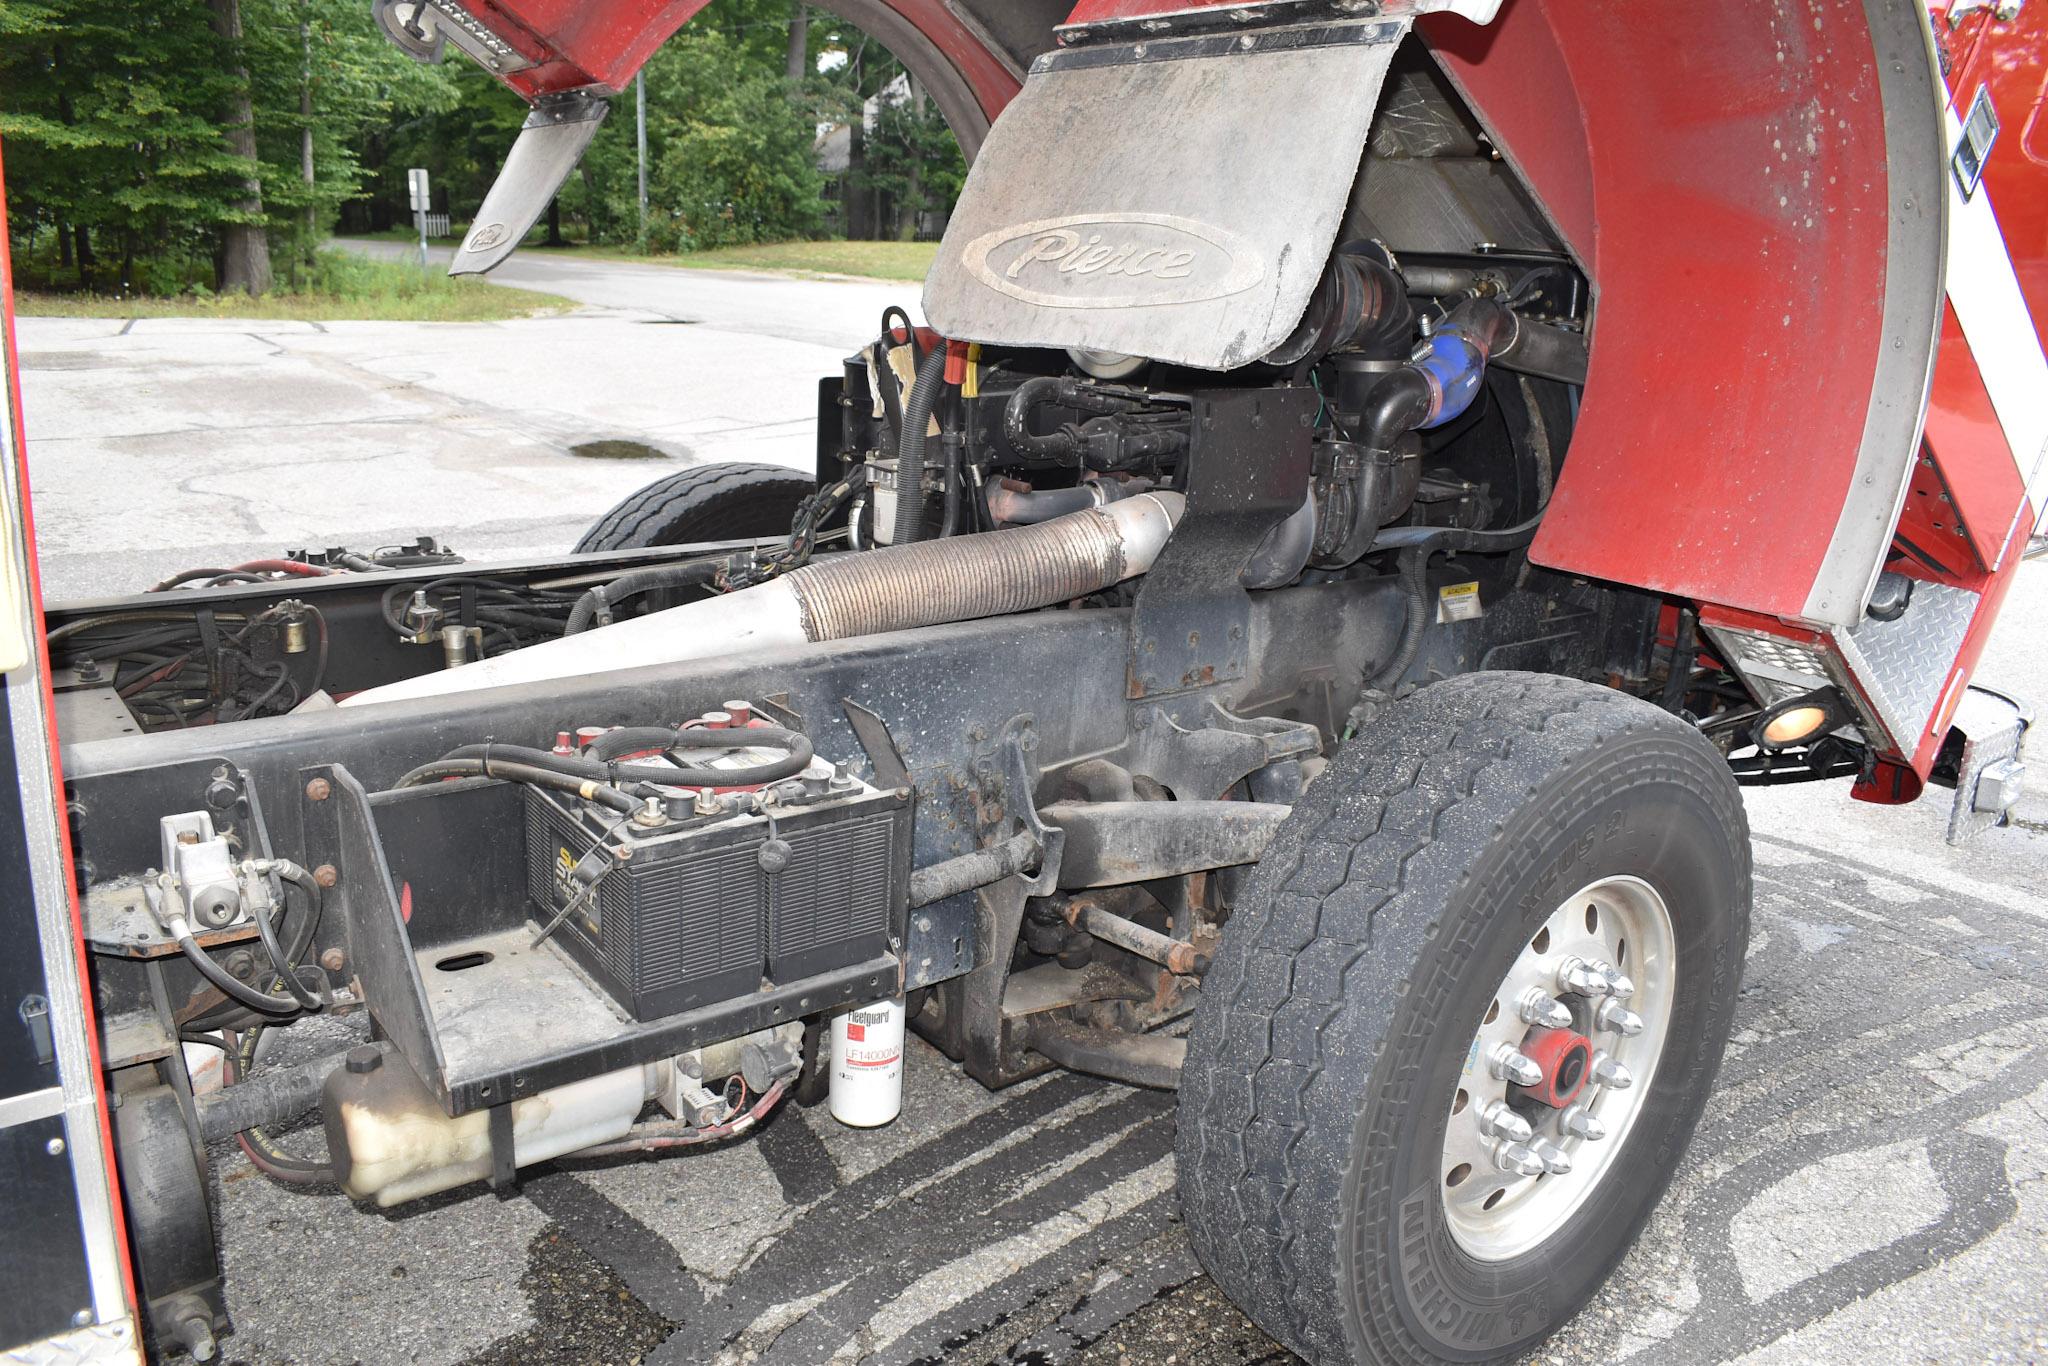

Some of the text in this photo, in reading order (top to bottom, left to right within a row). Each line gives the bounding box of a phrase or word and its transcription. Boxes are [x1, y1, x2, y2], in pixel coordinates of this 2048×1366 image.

[1006, 230, 1197, 279] Pierce
[848, 1008, 890, 1028] Fleetguard
[1403, 1200, 1505, 1343] MICHELIN
